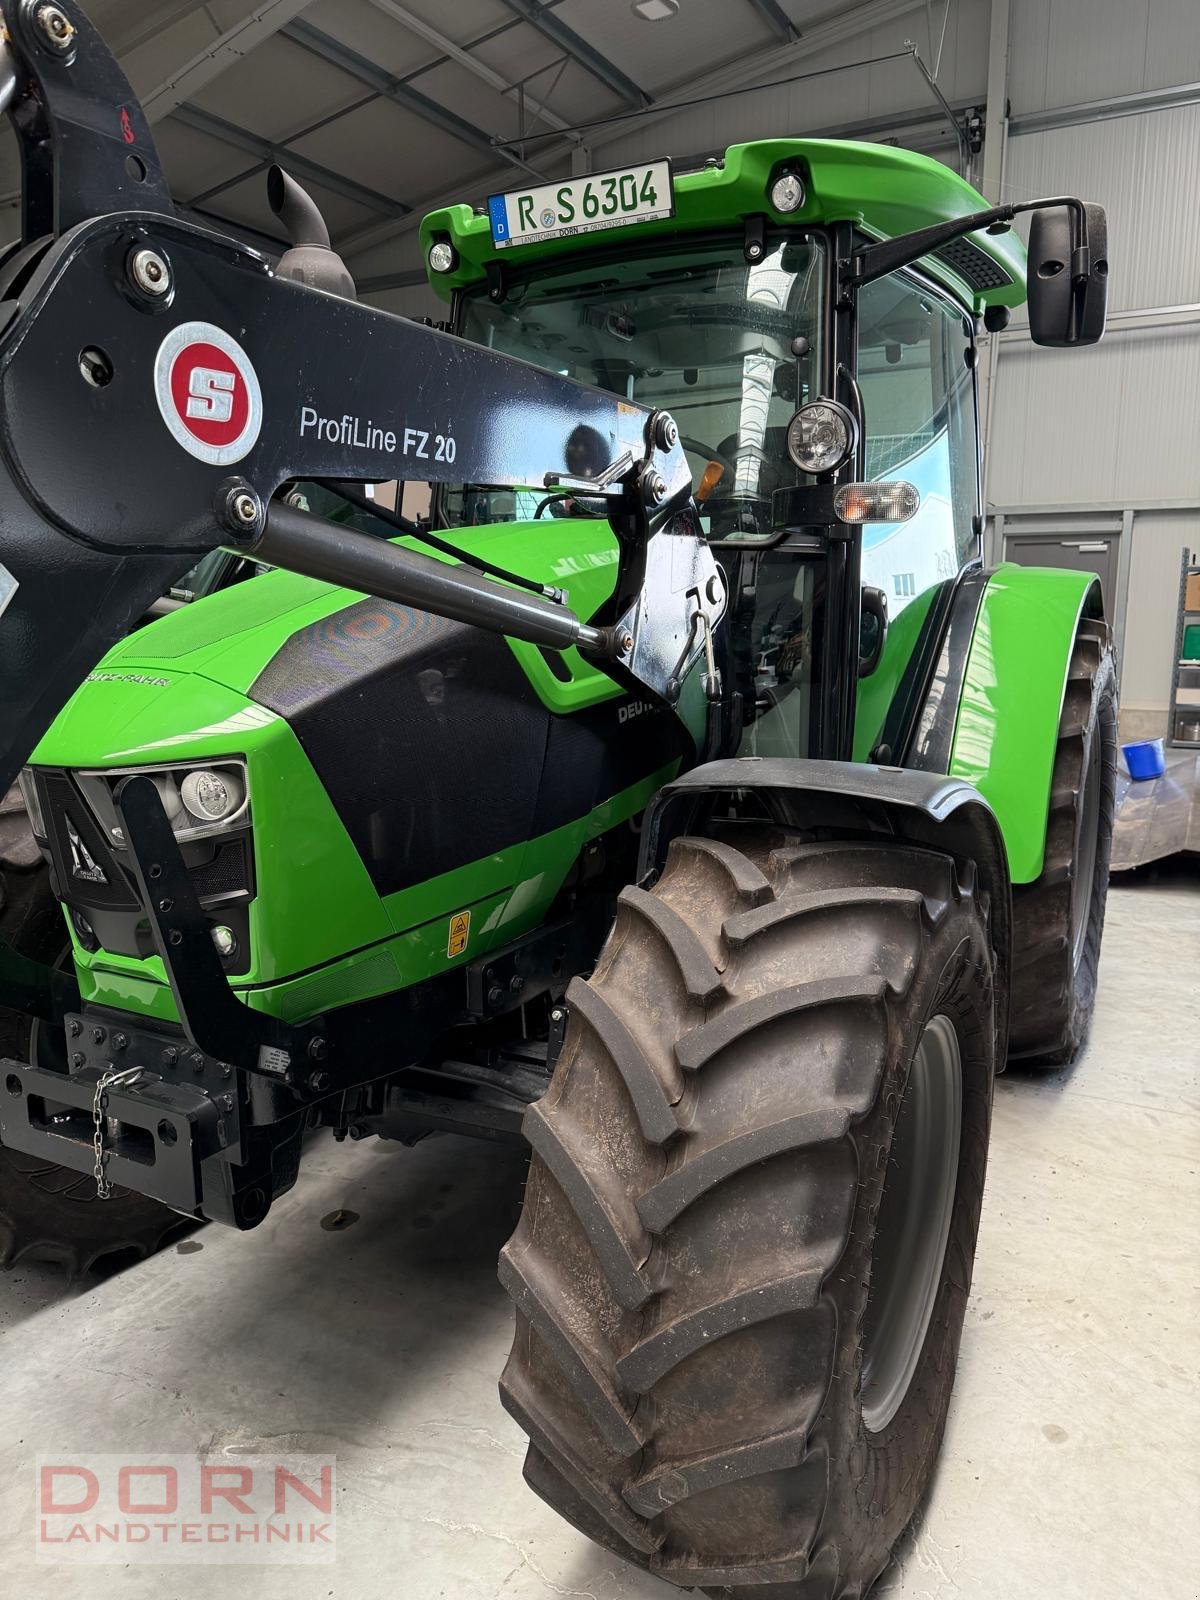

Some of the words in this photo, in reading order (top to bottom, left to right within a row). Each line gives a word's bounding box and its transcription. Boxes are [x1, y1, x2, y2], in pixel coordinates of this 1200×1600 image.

[518, 195, 538, 231] R
[497, 223, 505, 234] D
[558, 226, 579, 237] DORN
[299, 406, 397, 453] ProfiLine
[402, 427, 429, 459] FZ
[434, 434, 457, 464] 20
